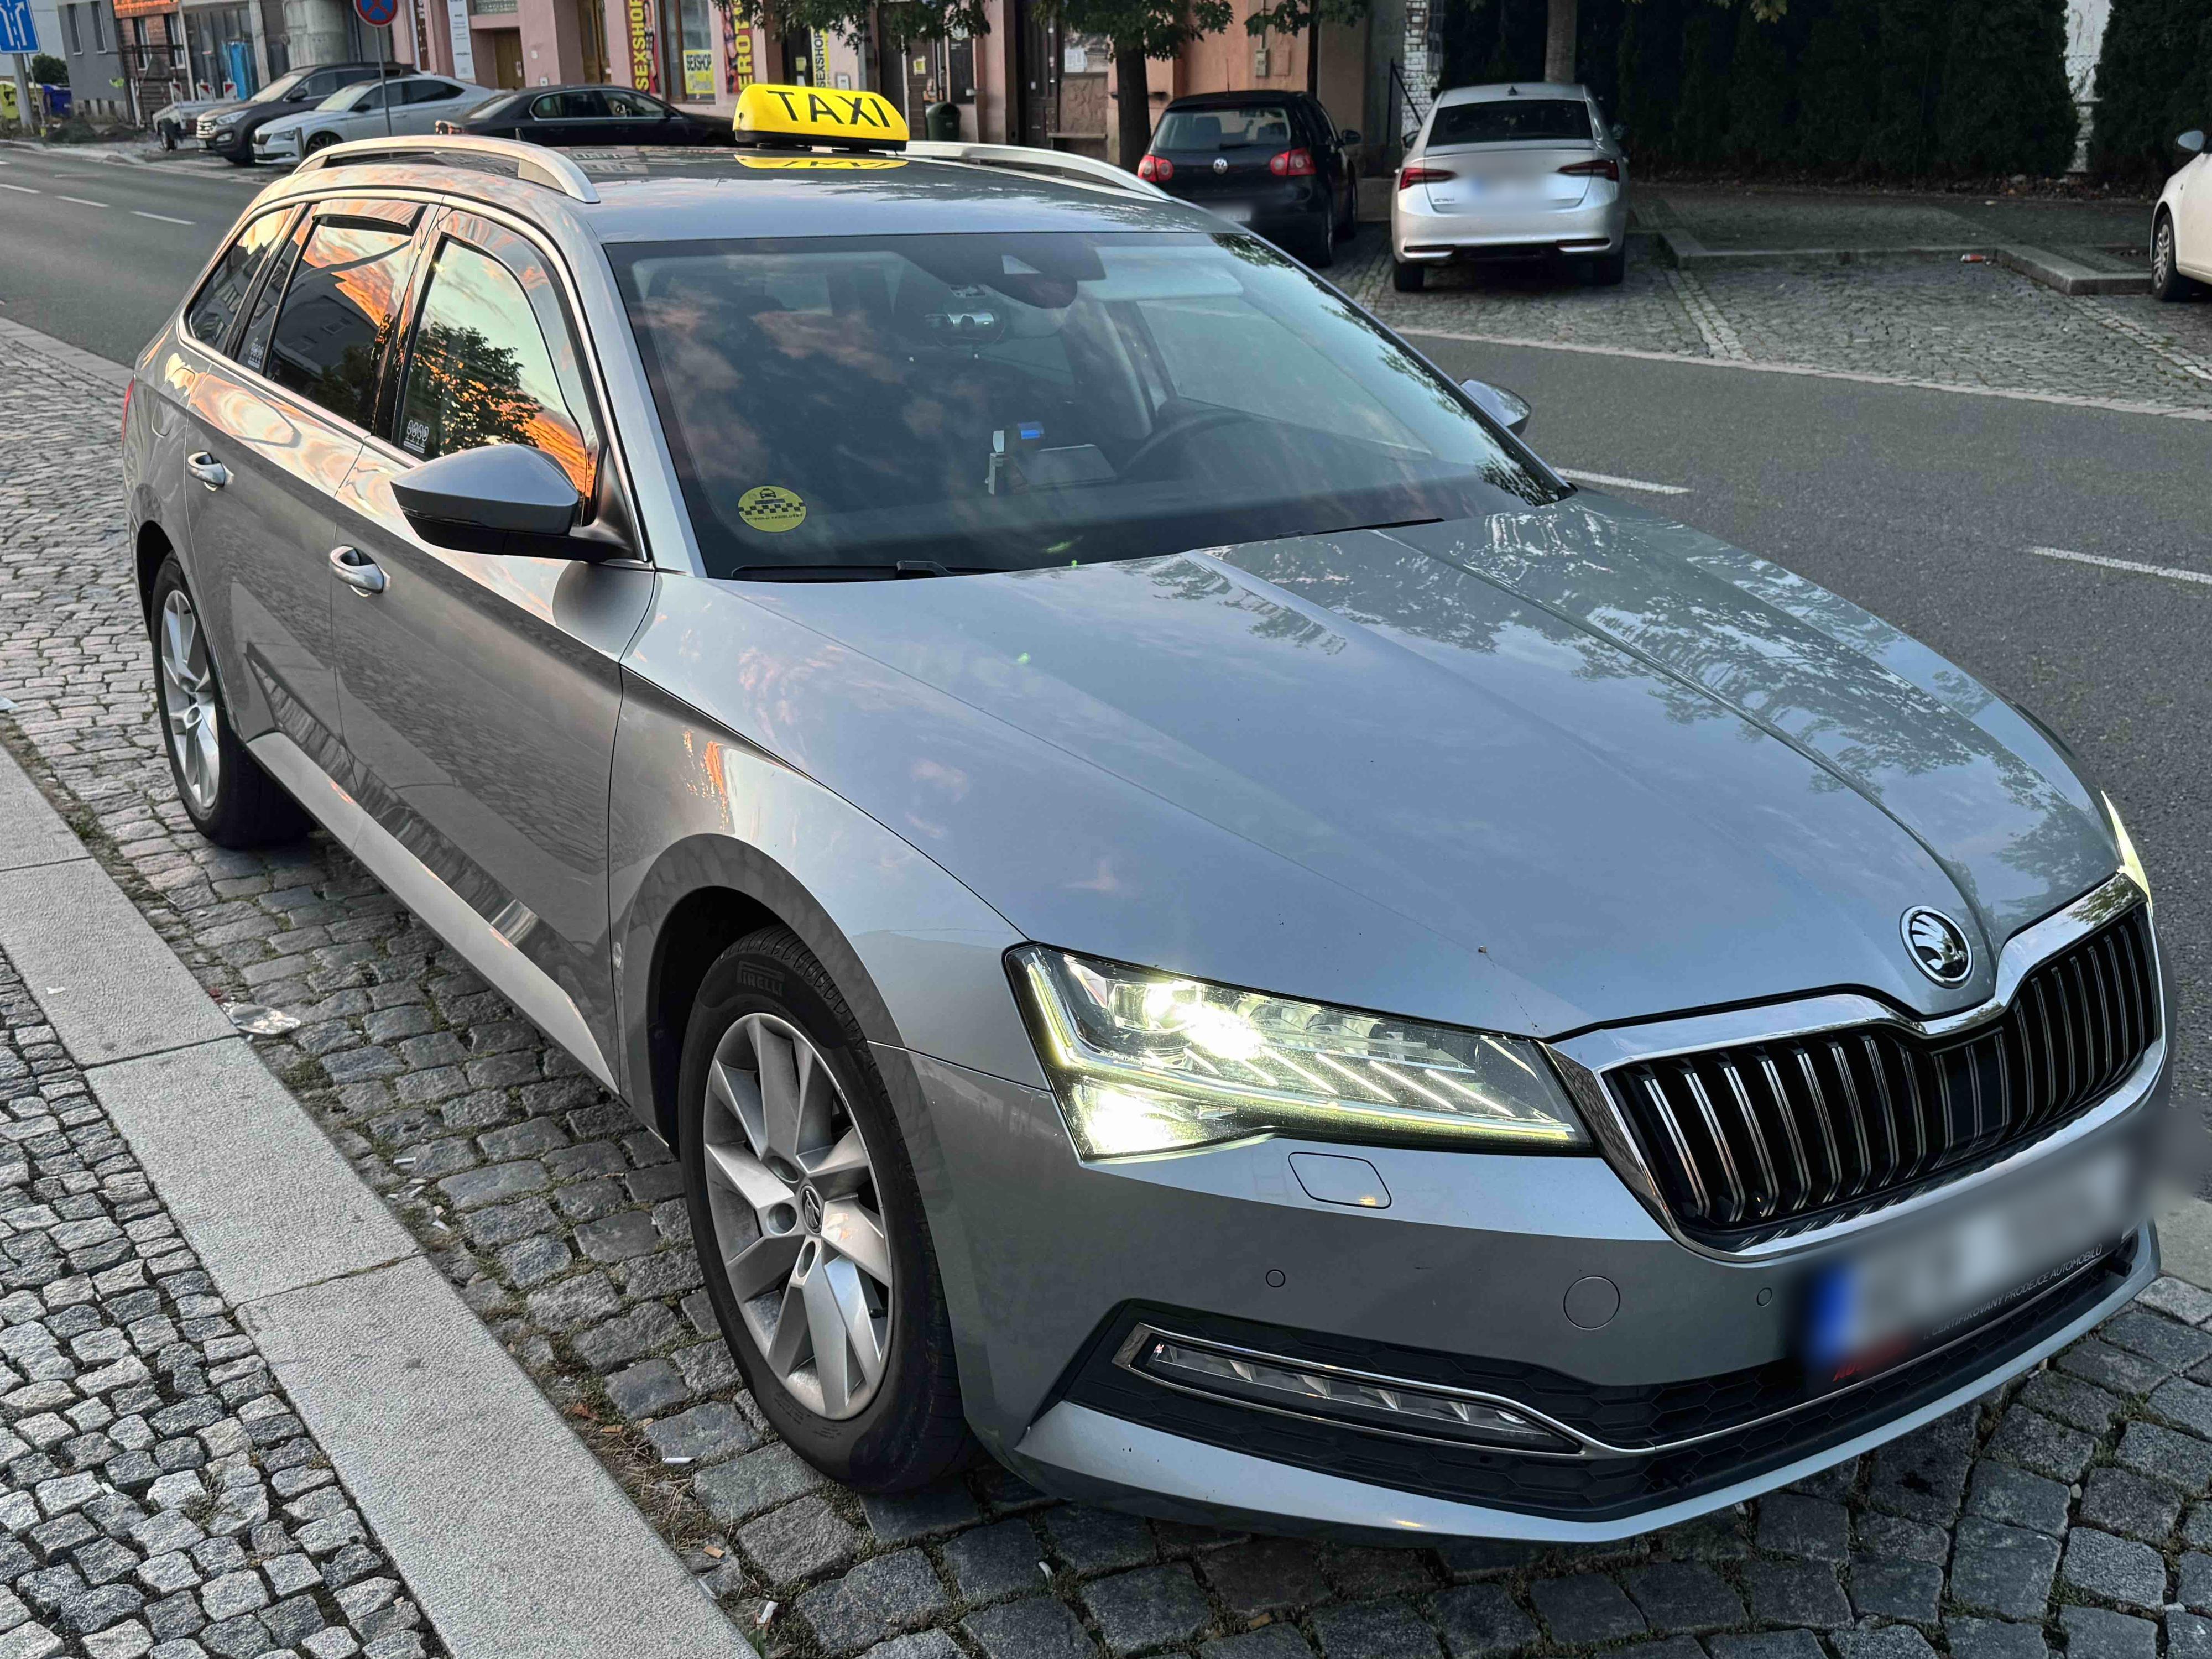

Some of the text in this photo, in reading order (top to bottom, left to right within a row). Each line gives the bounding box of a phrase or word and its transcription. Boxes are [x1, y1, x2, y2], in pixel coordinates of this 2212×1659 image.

[766, 90, 890, 128] TAXI
[737, 961, 785, 997] PIRELLI
[1932, 1293, 2005, 1336] CERTIFIKOVANÝ
[2005, 1271, 2049, 1302] PRODEJCE
[2049, 1243, 2102, 1279] AUTOMOBILŮ
